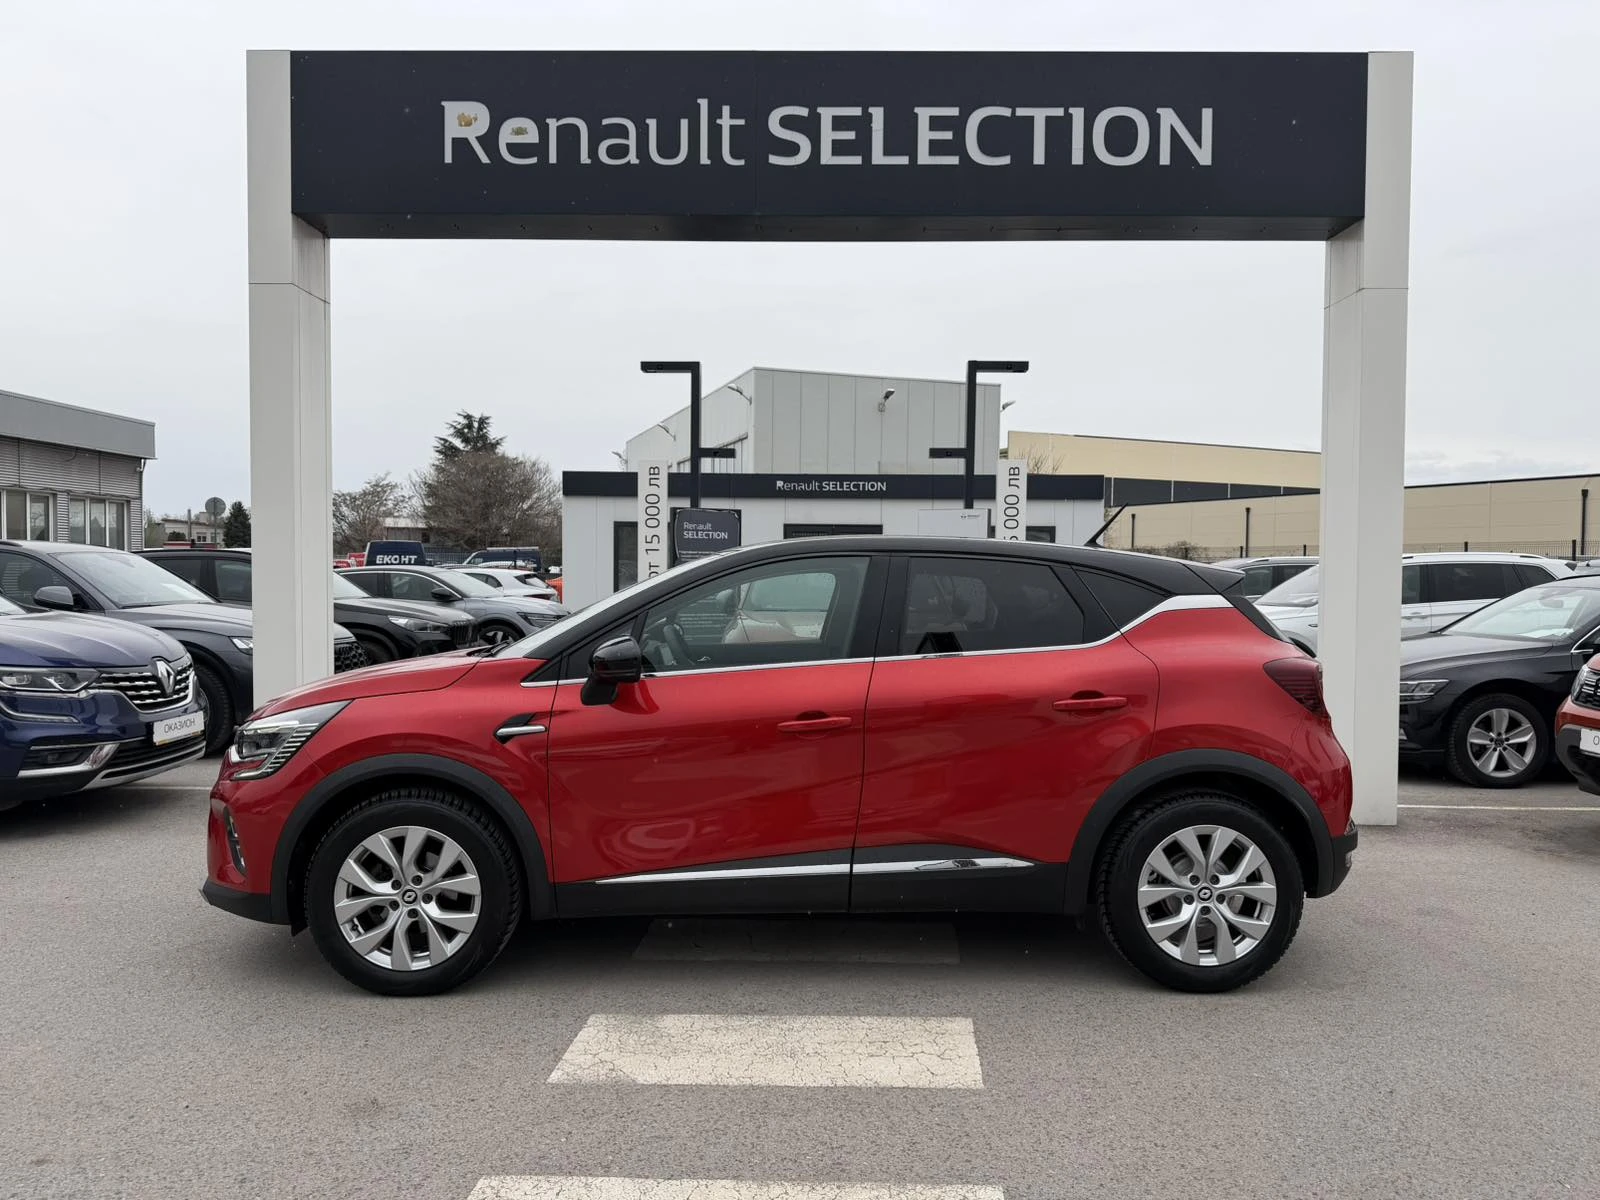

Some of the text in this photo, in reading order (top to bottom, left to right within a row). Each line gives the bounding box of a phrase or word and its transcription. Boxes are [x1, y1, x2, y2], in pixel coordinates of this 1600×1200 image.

[441, 98, 1214, 166] Renault SELECTION
[776, 481, 887, 491] Renault SELECTION
[645, 493, 660, 529] 000
[1003, 494, 1020, 530] 000
[683, 521, 712, 530] Renault
[683, 531, 728, 540] SELECTION
[645, 534, 660, 555] 15
[376, 555, 417, 565] ЕКОНТ
[164, 718, 195, 733] ОКАЗИОН
